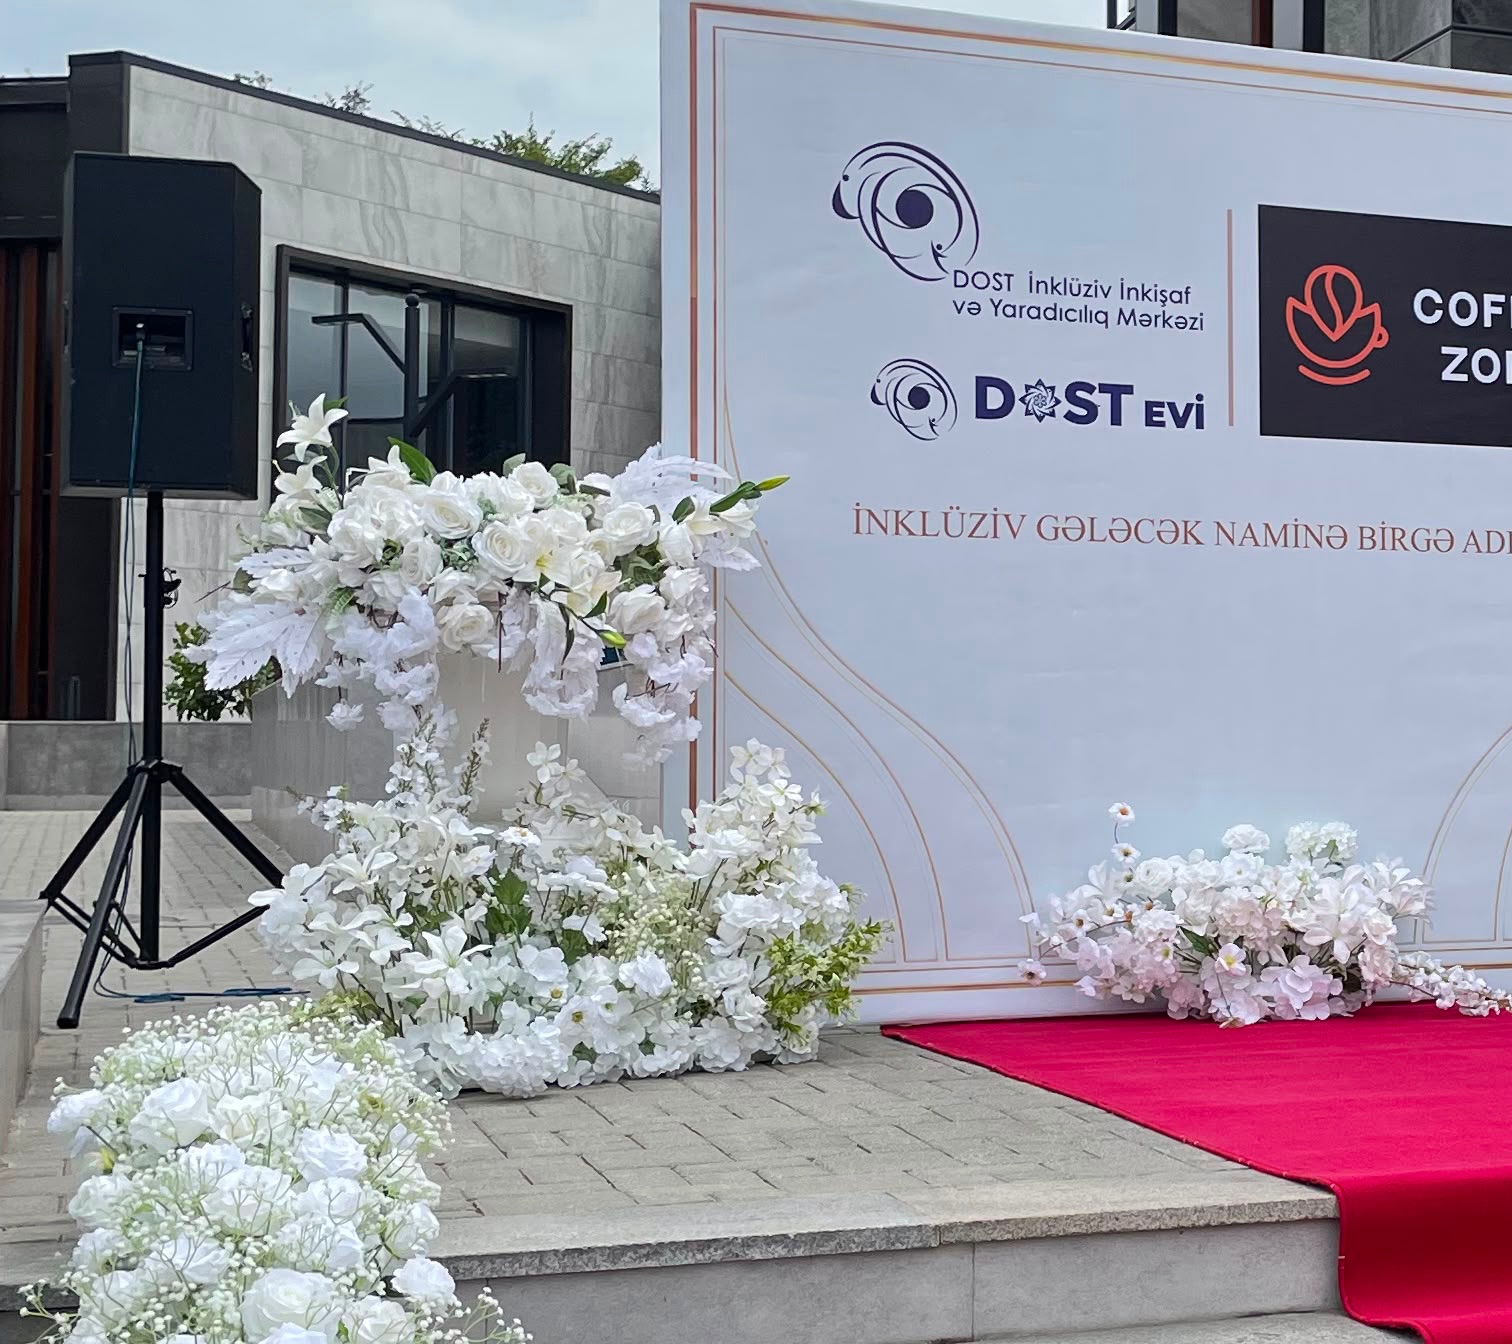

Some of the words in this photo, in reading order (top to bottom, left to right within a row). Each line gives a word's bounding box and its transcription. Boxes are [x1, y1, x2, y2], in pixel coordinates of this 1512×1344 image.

[953, 269, 1015, 292] DOST
[1028, 270, 1112, 299] İnklüziv
[1119, 277, 1192, 307] İnkişaf
[952, 299, 982, 316] və
[989, 297, 1109, 329] Yaradıcılıq
[1116, 307, 1205, 332] Mərkəzi
[852, 502, 1028, 540] İNKLÜZİV
[1036, 514, 1205, 546] GƏLƏCƏK
[1213, 517, 1349, 550] NAMİNƏ
[1357, 520, 1456, 553] BİRGƏ
